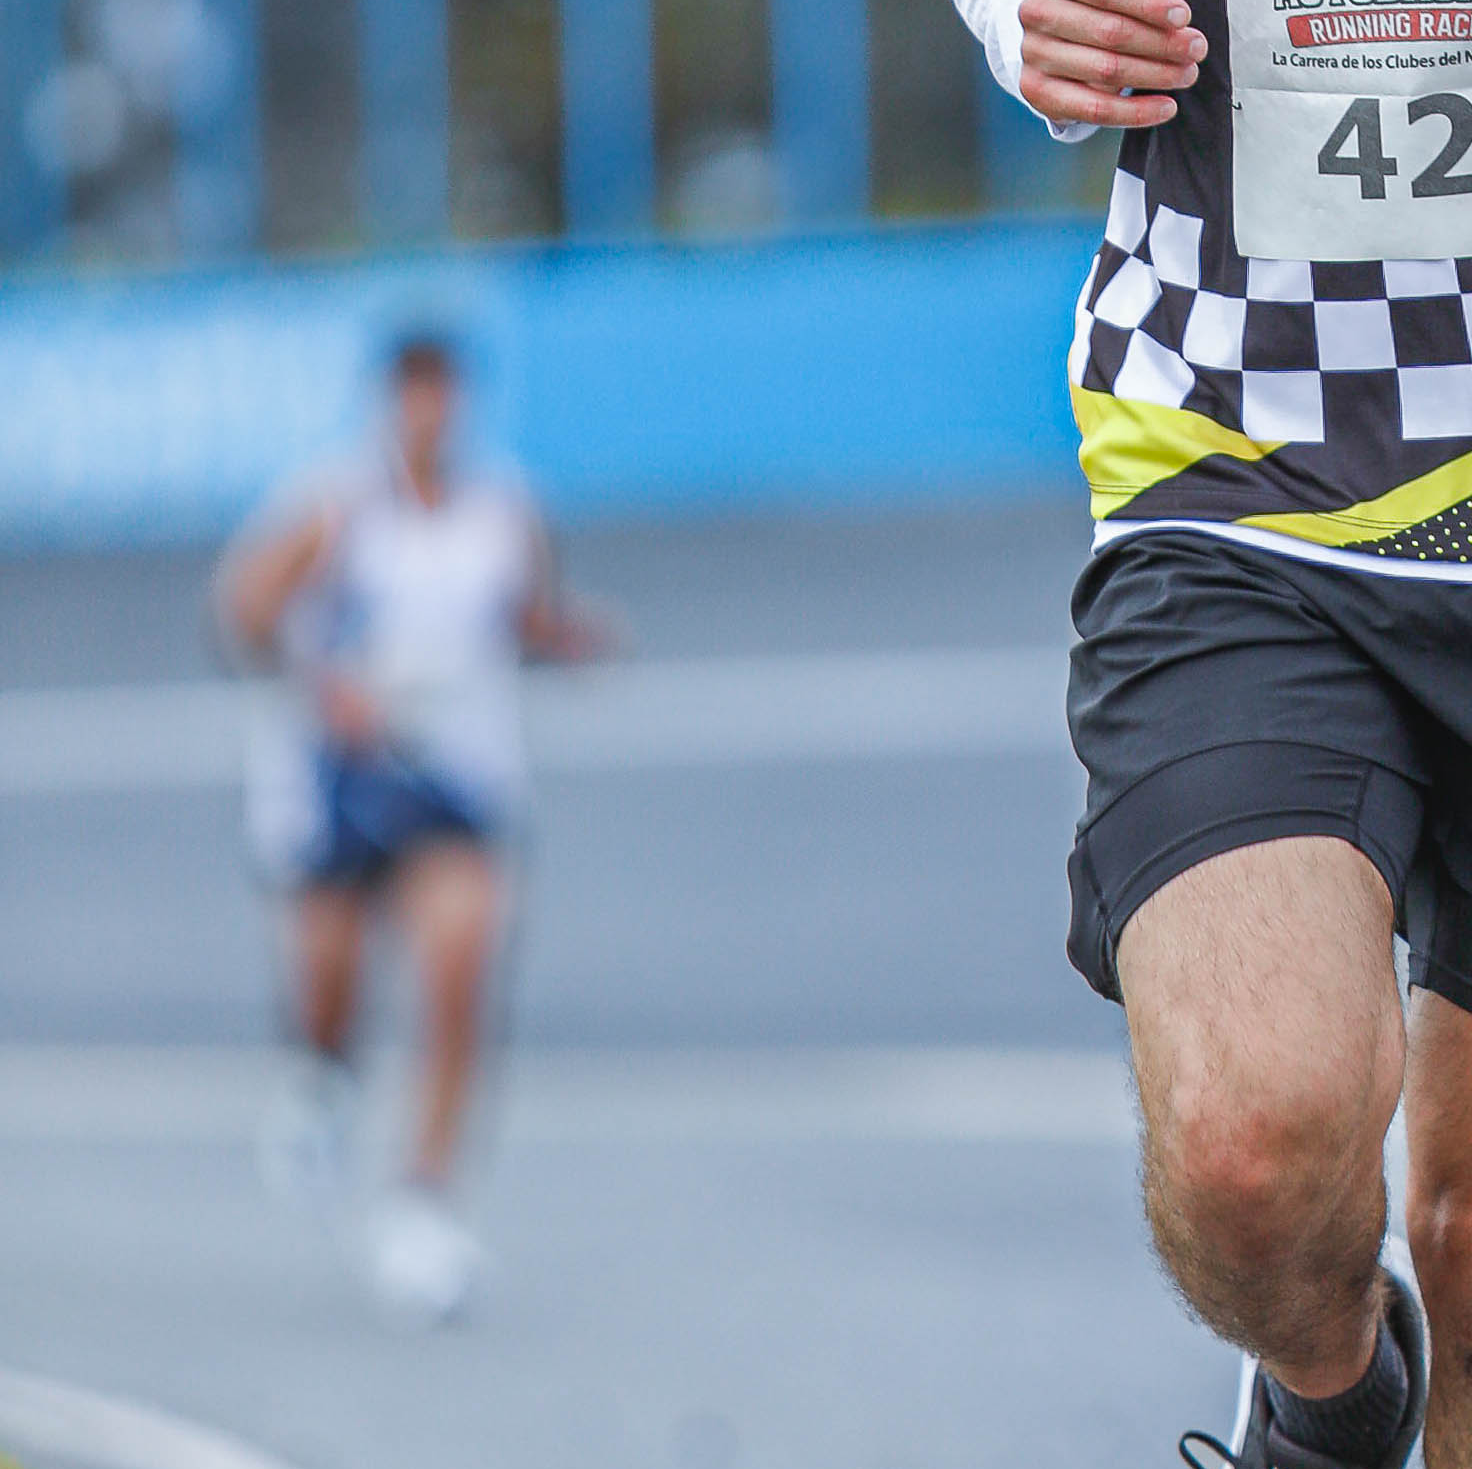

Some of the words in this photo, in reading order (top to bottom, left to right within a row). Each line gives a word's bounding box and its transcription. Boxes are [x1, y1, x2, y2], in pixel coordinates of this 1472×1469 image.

[1307, 11, 1411, 44] RUNNING
[1272, 51, 1288, 66] La
[1290, 52, 1339, 69] Carrera
[1341, 54, 1359, 69] de
[1362, 54, 1383, 69] los
[1385, 53, 1436, 69] Clubes
[1438, 51, 1462, 67] del
